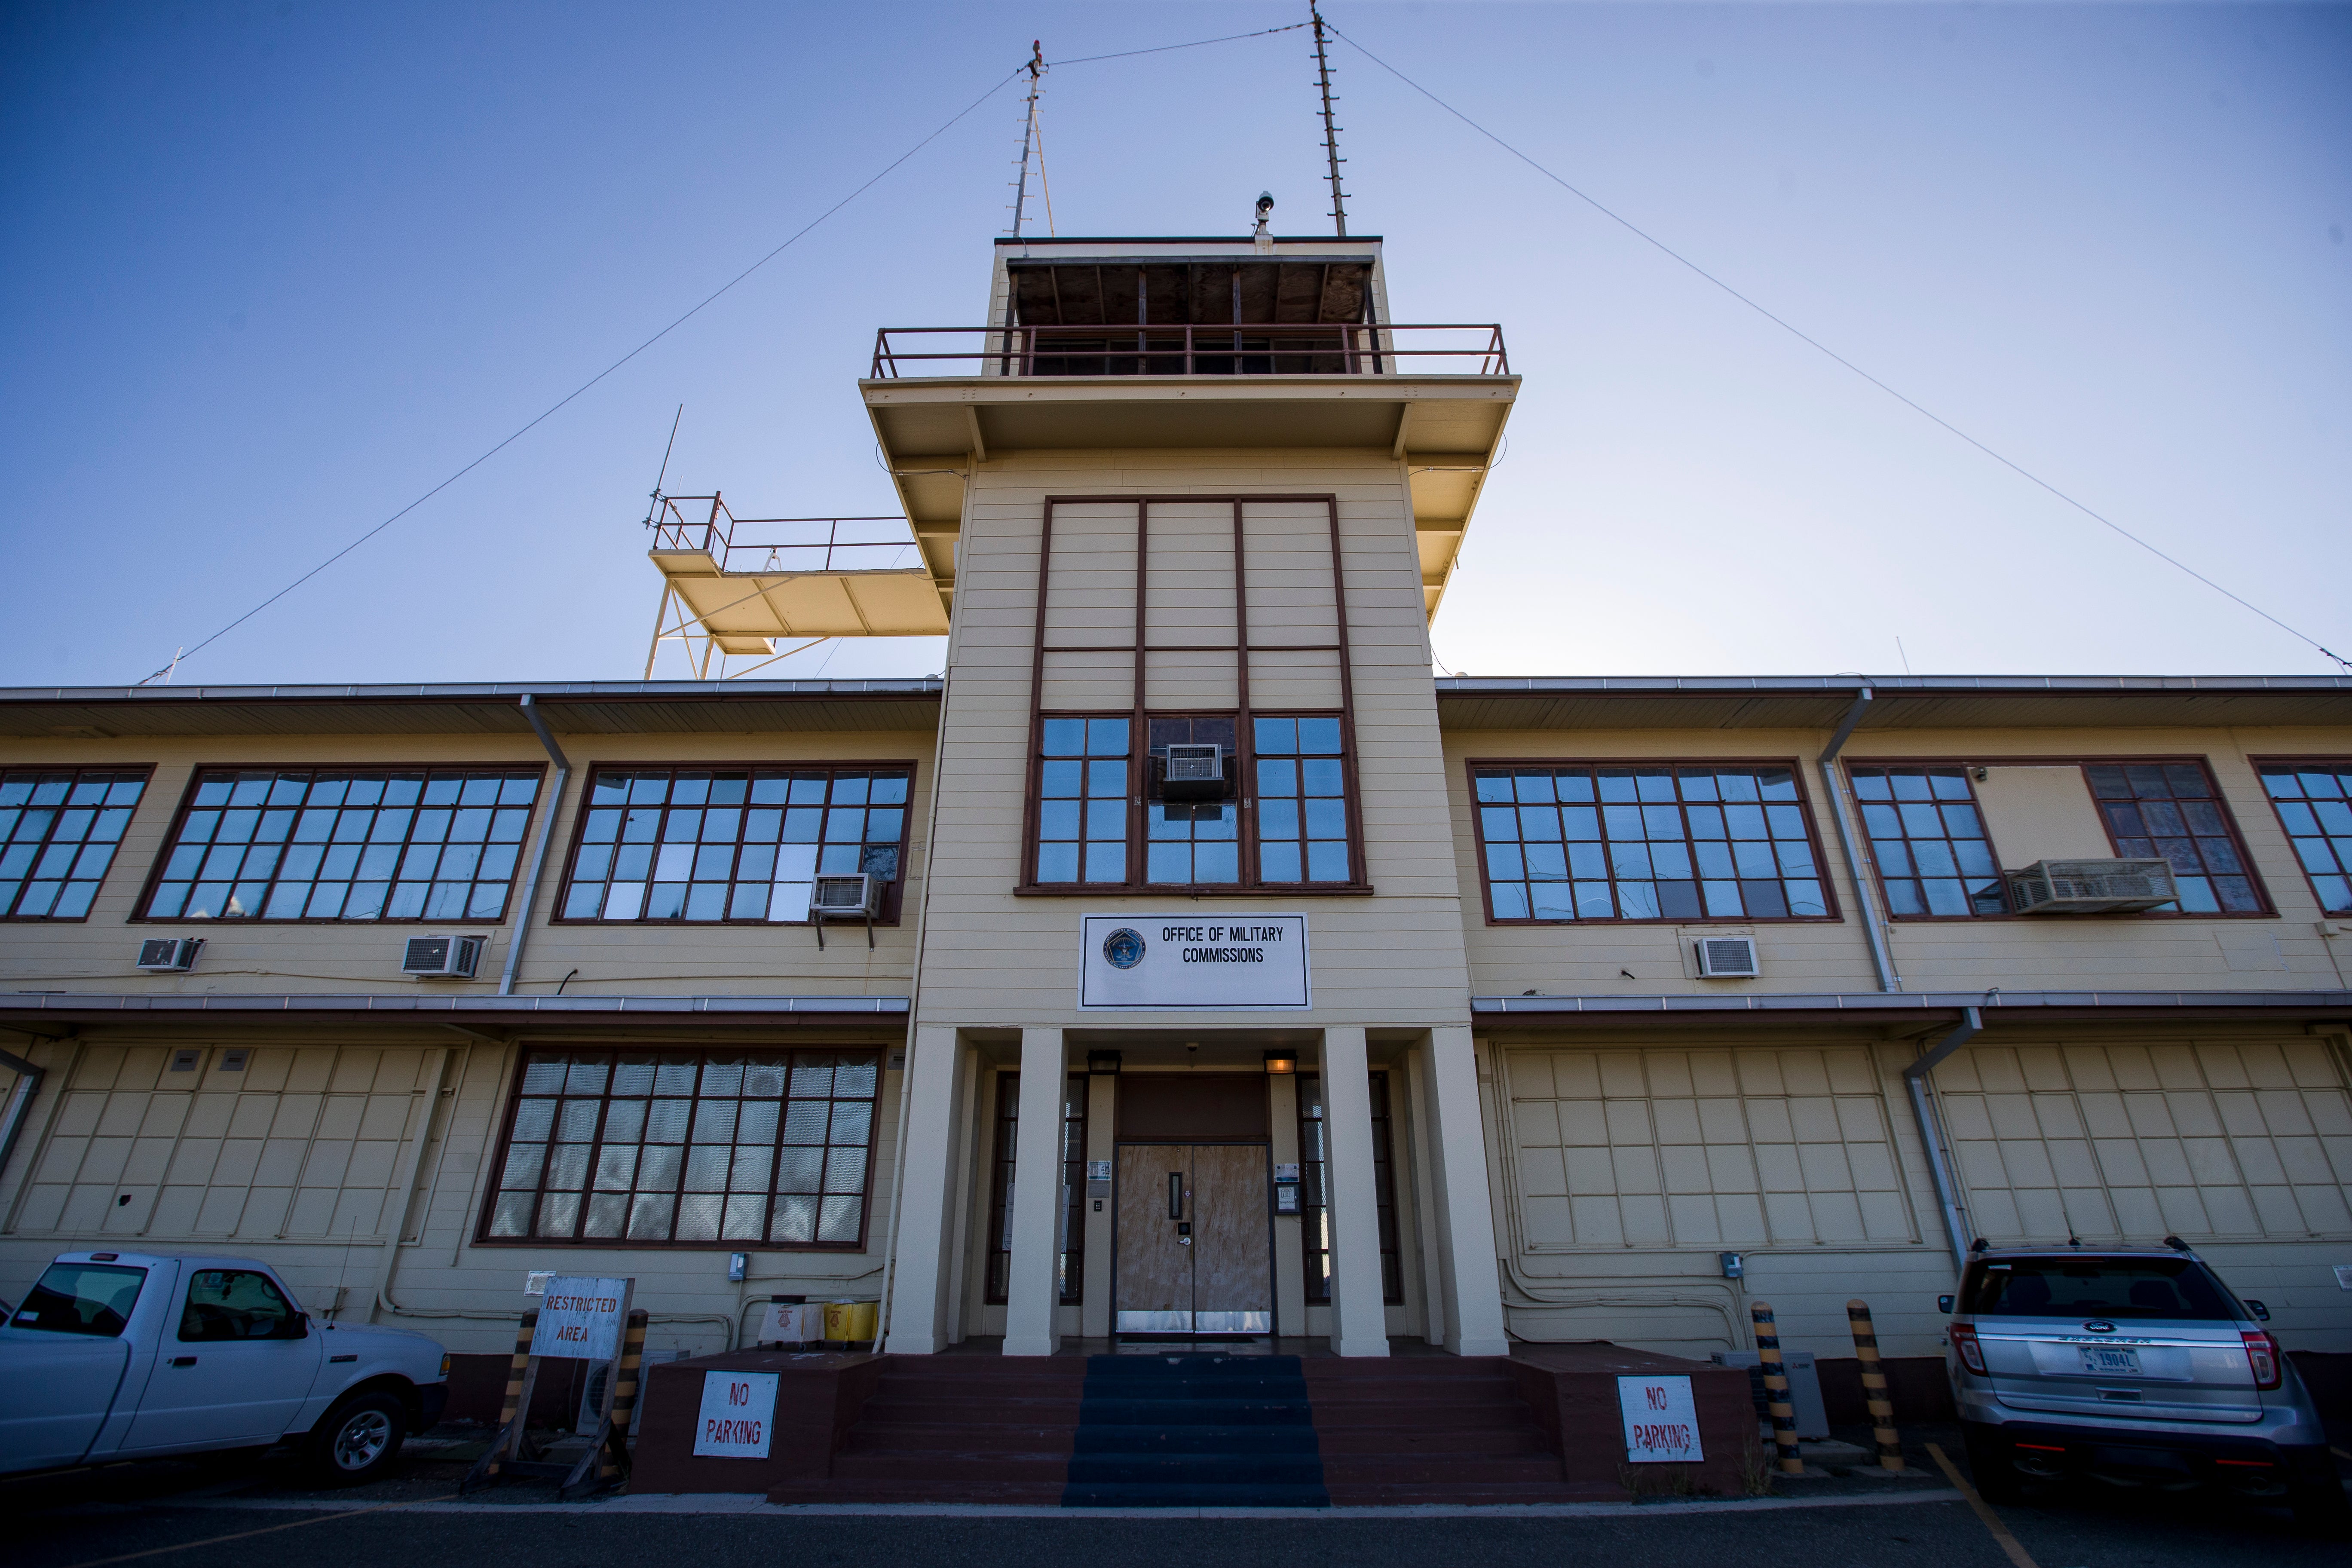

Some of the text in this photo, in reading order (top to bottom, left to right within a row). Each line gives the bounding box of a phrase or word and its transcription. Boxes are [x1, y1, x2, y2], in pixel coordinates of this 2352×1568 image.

[1105, 928, 1125, 943] DEPARTMENT
[1132, 930, 1144, 943] DEFENSE
[1162, 927, 1283, 941] OFFICE OF MILITARY
[1128, 951, 1145, 968] COMMISSIONS
[1183, 948, 1264, 963] COMMISSIONS
[546, 1295, 616, 1313] RESTRICTED
[556, 1326, 588, 1341] AREA
[2099, 1353, 2135, 1367] 1904L
[729, 1383, 749, 1406] NO
[1646, 1387, 1667, 1410] NO
[705, 1419, 761, 1444] PARKING
[1633, 1424, 1690, 1449] PARKING
